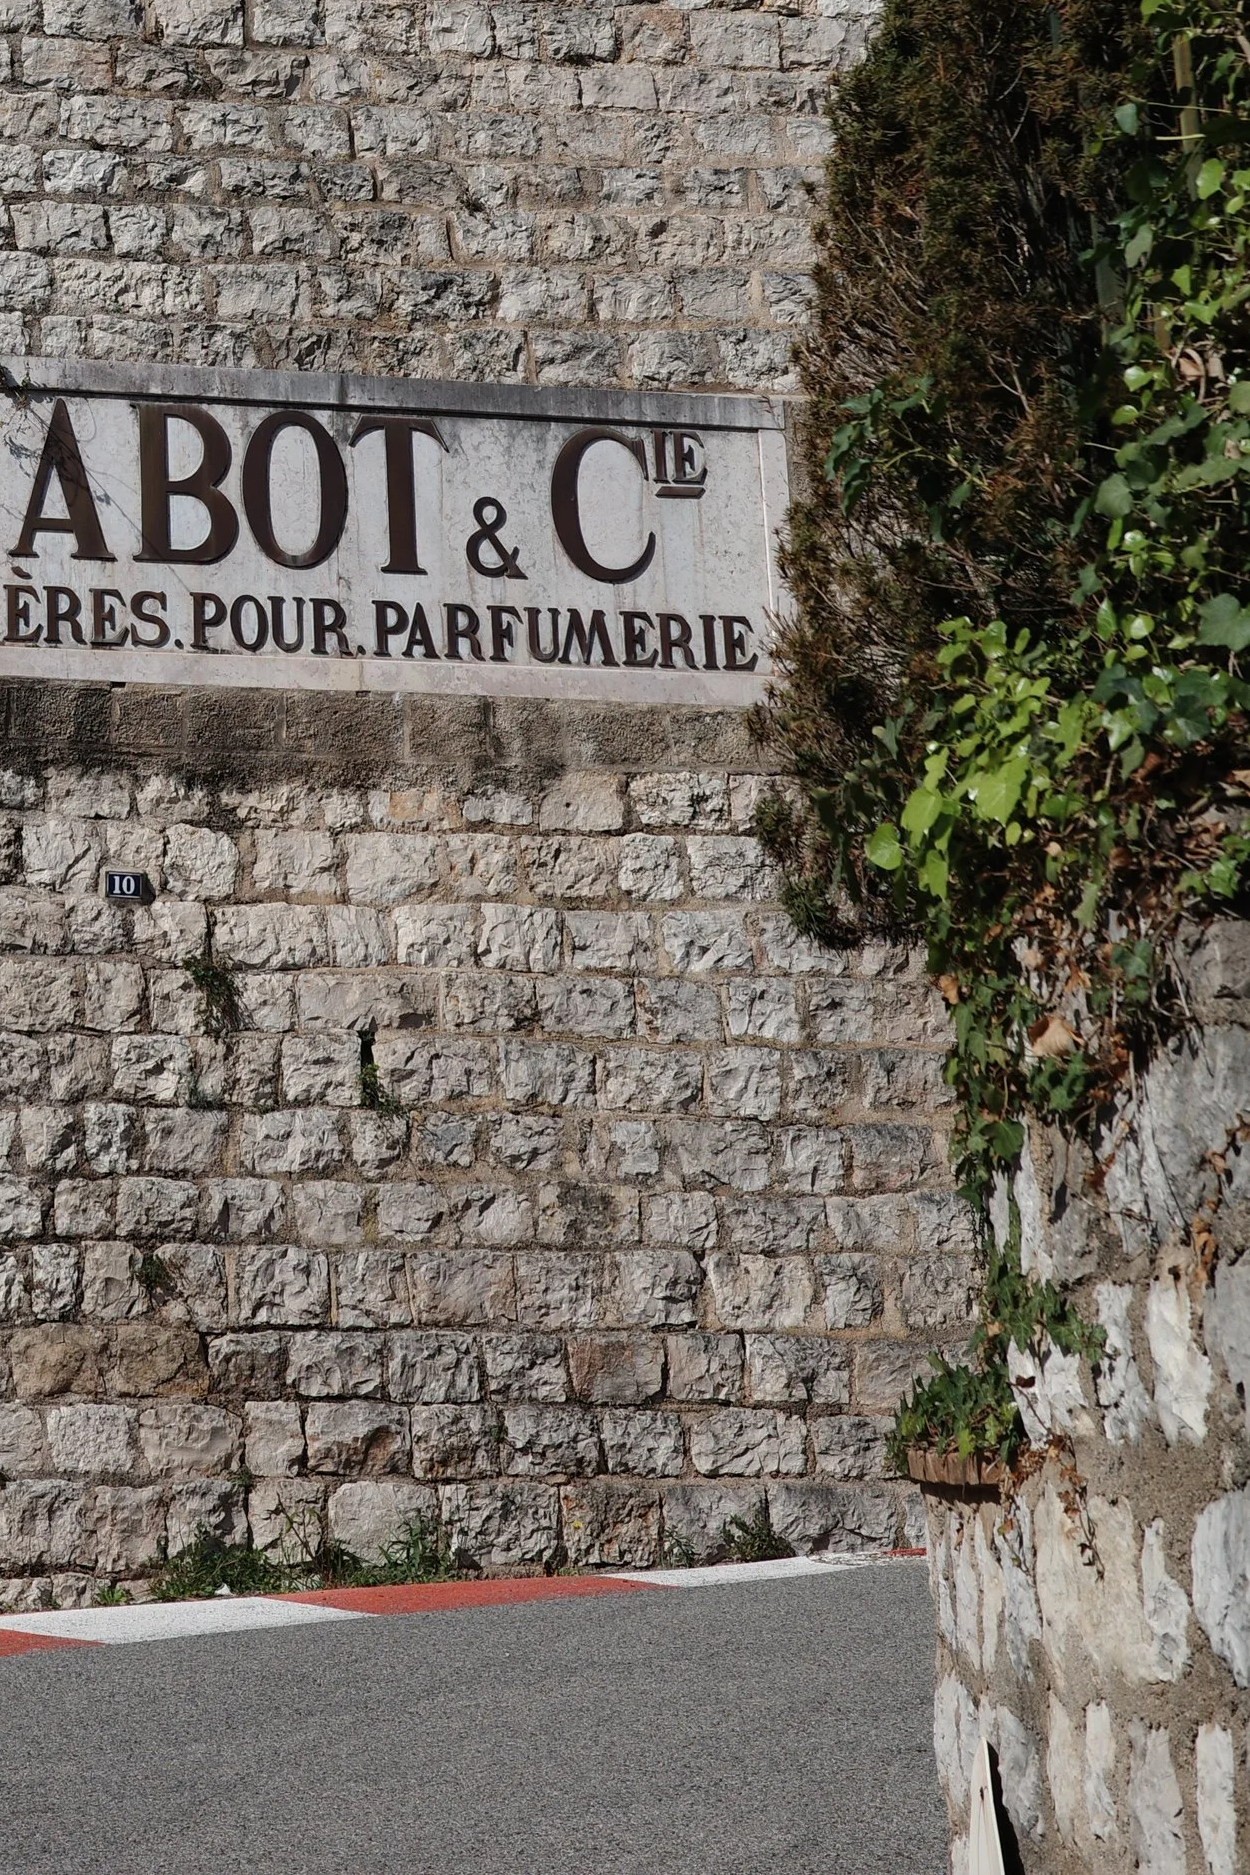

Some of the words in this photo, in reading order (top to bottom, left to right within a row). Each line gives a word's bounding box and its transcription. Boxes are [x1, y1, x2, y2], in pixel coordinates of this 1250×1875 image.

[466, 496, 528, 580] &
[371, 599, 759, 672] PARFUMERIE
[112, 875, 136, 895] 10
